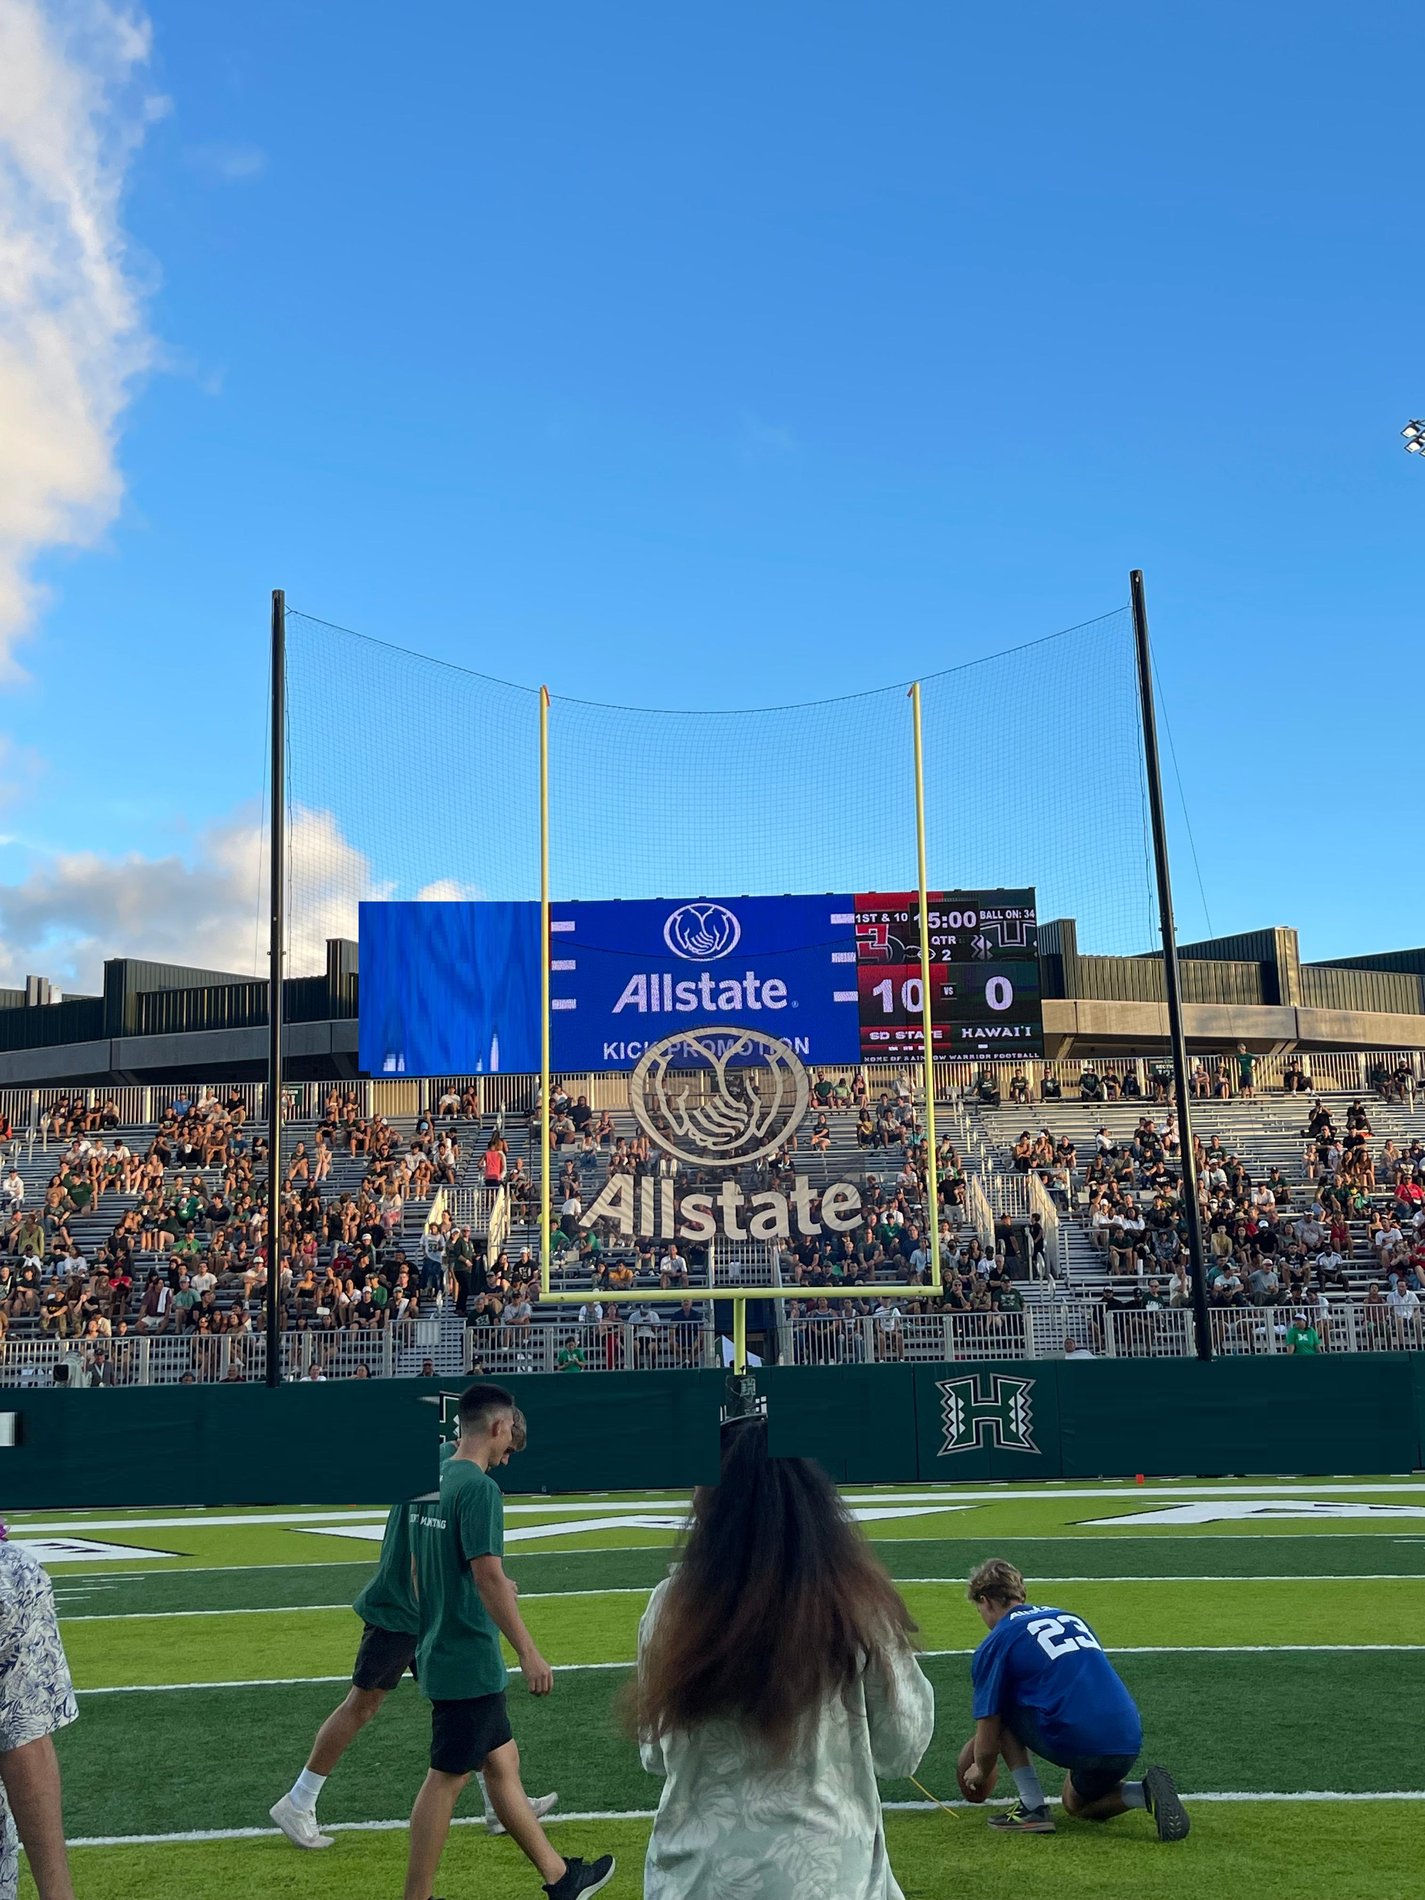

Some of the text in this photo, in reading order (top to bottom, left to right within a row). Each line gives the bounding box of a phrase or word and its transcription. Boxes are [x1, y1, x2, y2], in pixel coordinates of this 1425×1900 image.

[855, 913, 878, 923] 1ST
[894, 912, 908, 922] 10
[913, 911, 977, 928] 15:00
[980, 907, 1035, 920] BALL ON: 34
[931, 935, 957, 946] QTR
[941, 949, 953, 961] 2
[611, 971, 788, 1013] Allstate
[872, 978, 924, 1013] 10
[943, 986, 954, 996] VS
[985, 976, 1014, 1011] 0
[895, 1030, 943, 1039] STAE
[578, 1173, 866, 1240] Allstate
[1026, 1614, 1103, 1661] 23
